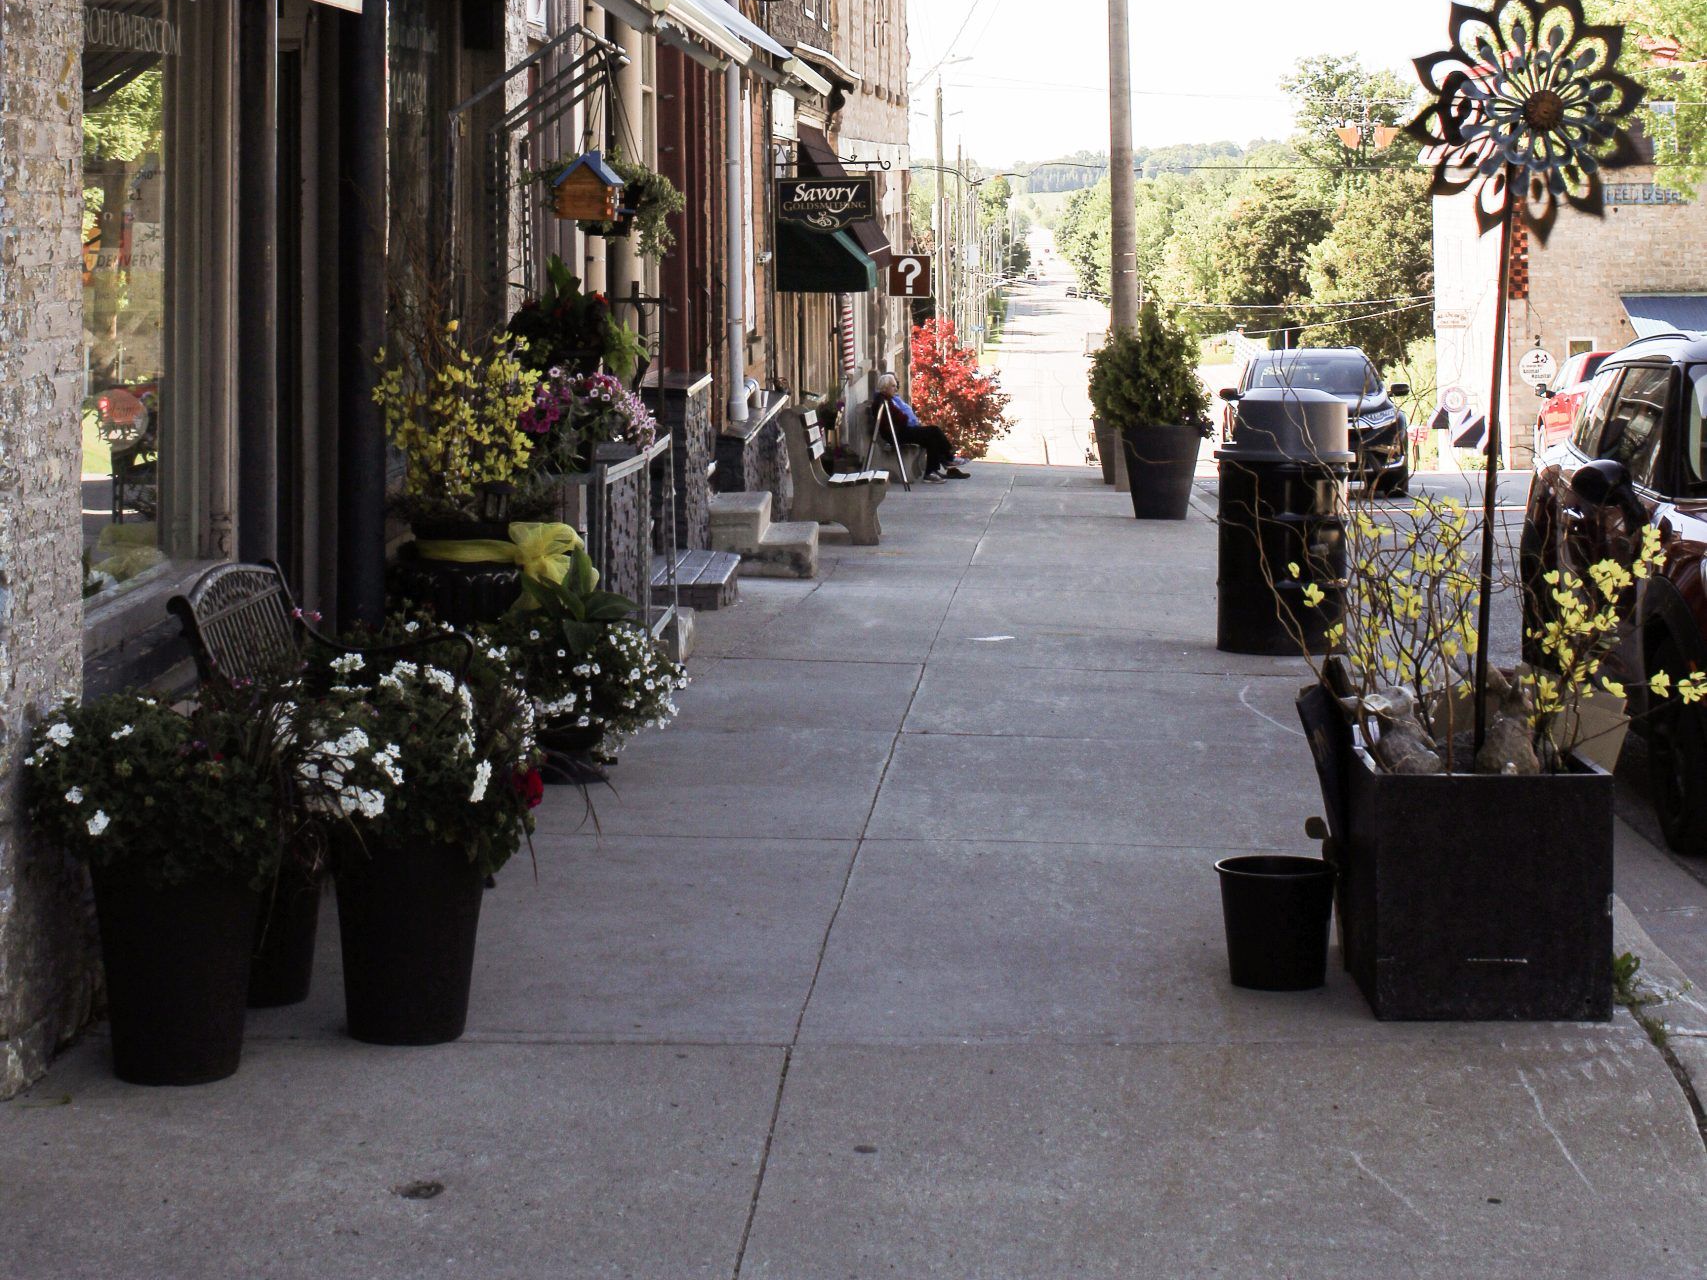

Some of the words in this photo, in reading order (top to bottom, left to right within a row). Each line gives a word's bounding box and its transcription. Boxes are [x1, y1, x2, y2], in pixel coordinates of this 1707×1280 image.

[793, 183, 860, 213] Savory
[783, 201, 867, 212] GOLDSMITHING
[96, 254, 155, 267] DELIVERY
